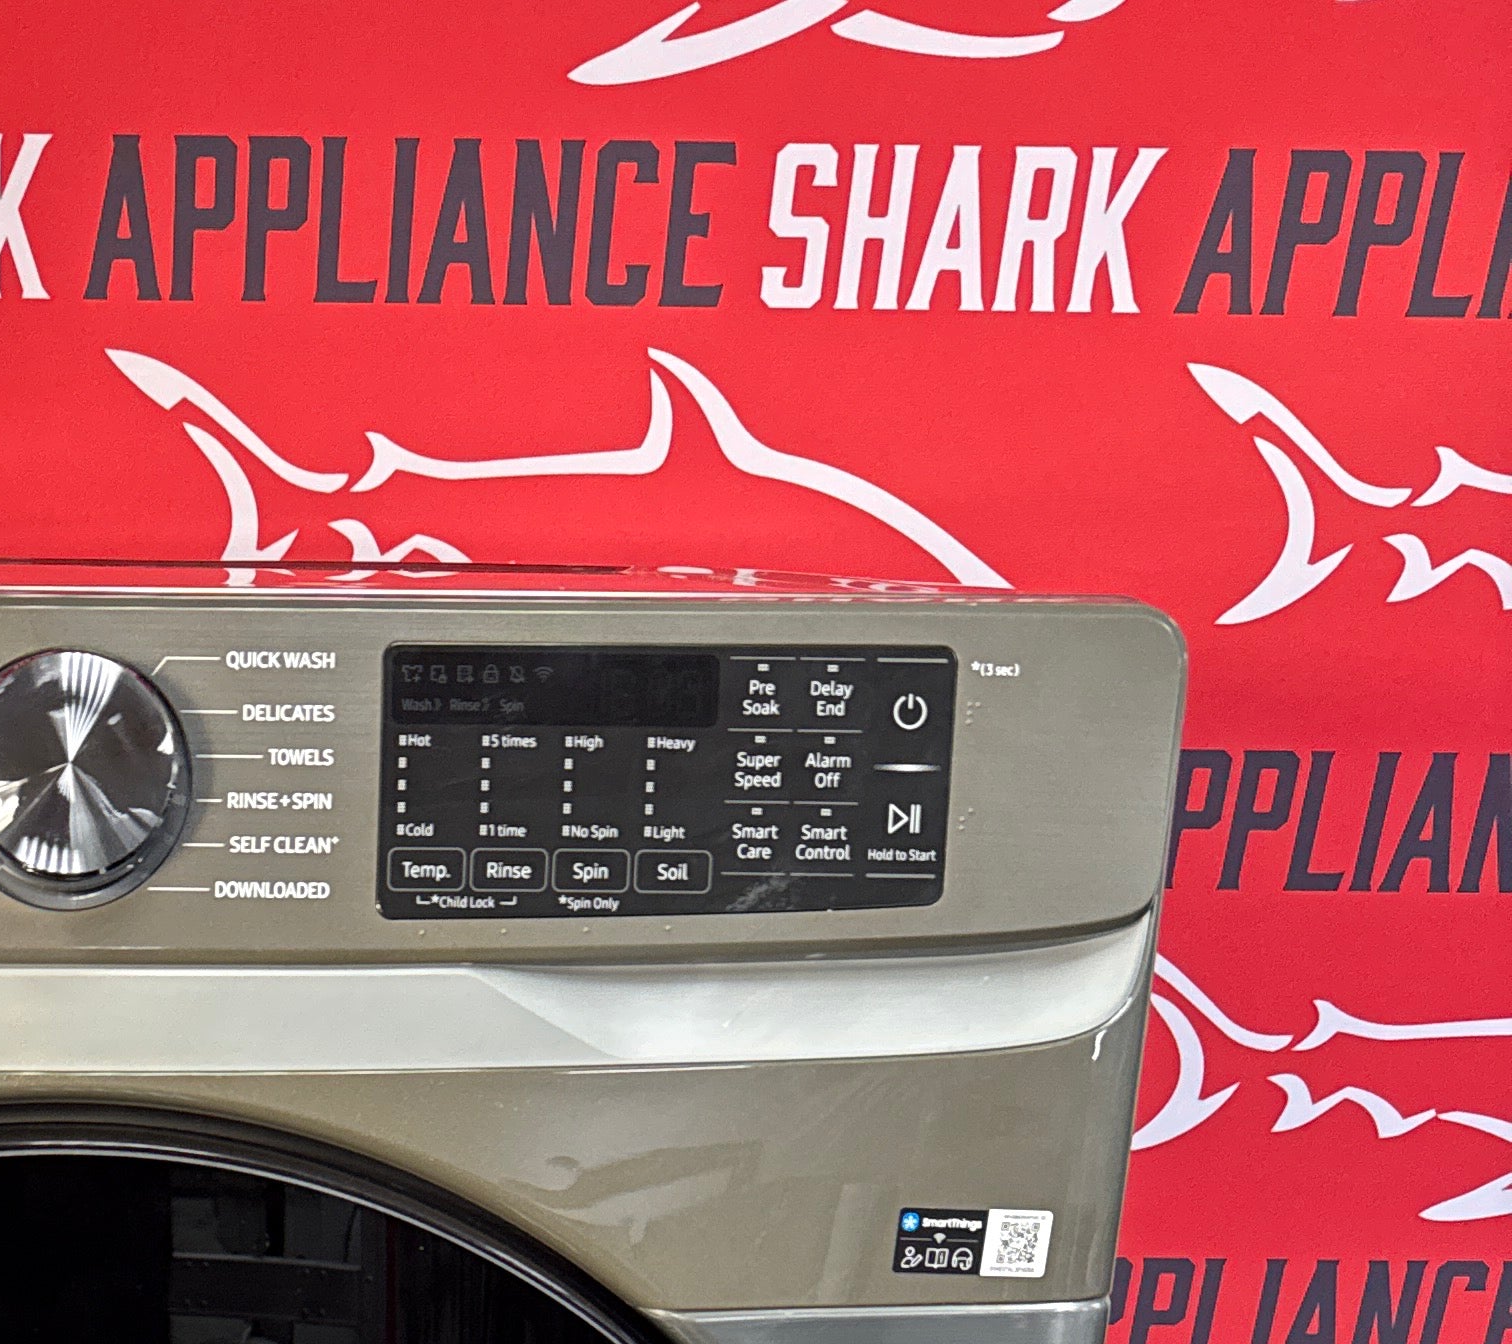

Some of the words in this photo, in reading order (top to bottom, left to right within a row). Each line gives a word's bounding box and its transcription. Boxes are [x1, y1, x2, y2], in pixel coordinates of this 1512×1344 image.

[83, 133, 738, 309] APPLIANCE
[760, 142, 1169, 315] SHARK
[1173, 147, 1512, 320] APPLI
[225, 651, 280, 669] QUICK
[284, 652, 336, 669] WASH
[995, 663, 1020, 677] sec)
[749, 680, 776, 695] Pre
[810, 680, 853, 699] Delay
[242, 704, 335, 722] DELICATES
[742, 700, 780, 715] Soak
[816, 701, 845, 716] End
[407, 734, 432, 748] Hot
[490, 734, 500, 748] 5
[501, 734, 537, 748] times
[573, 735, 604, 751] High
[656, 736, 696, 752] Heavy
[268, 748, 334, 766] TOWELS
[736, 752, 781, 771] Super
[804, 753, 851, 769] Alarm
[734, 772, 782, 790] Speed
[814, 772, 841, 788] Off
[405, 823, 434, 837] Cold
[488, 824, 496, 838] 1
[497, 824, 527, 838] time
[571, 825, 589, 839] No
[590, 825, 619, 841] Spin
[653, 825, 686, 841] Light
[732, 824, 779, 840] Smart
[800, 825, 848, 841] Smart
[229, 835, 272, 854] SELF
[737, 844, 772, 860] Care
[795, 844, 851, 861] Control
[867, 849, 893, 861] Hold
[895, 850, 906, 861] to
[908, 849, 936, 862] Start
[402, 862, 451, 881] Temp.
[486, 863, 532, 879] Rinse
[572, 863, 609, 881] Spin
[657, 863, 688, 880] Soil
[214, 881, 330, 899] DOWNLOADED
[469, 896, 495, 909] Lock
[593, 897, 619, 912] Only
